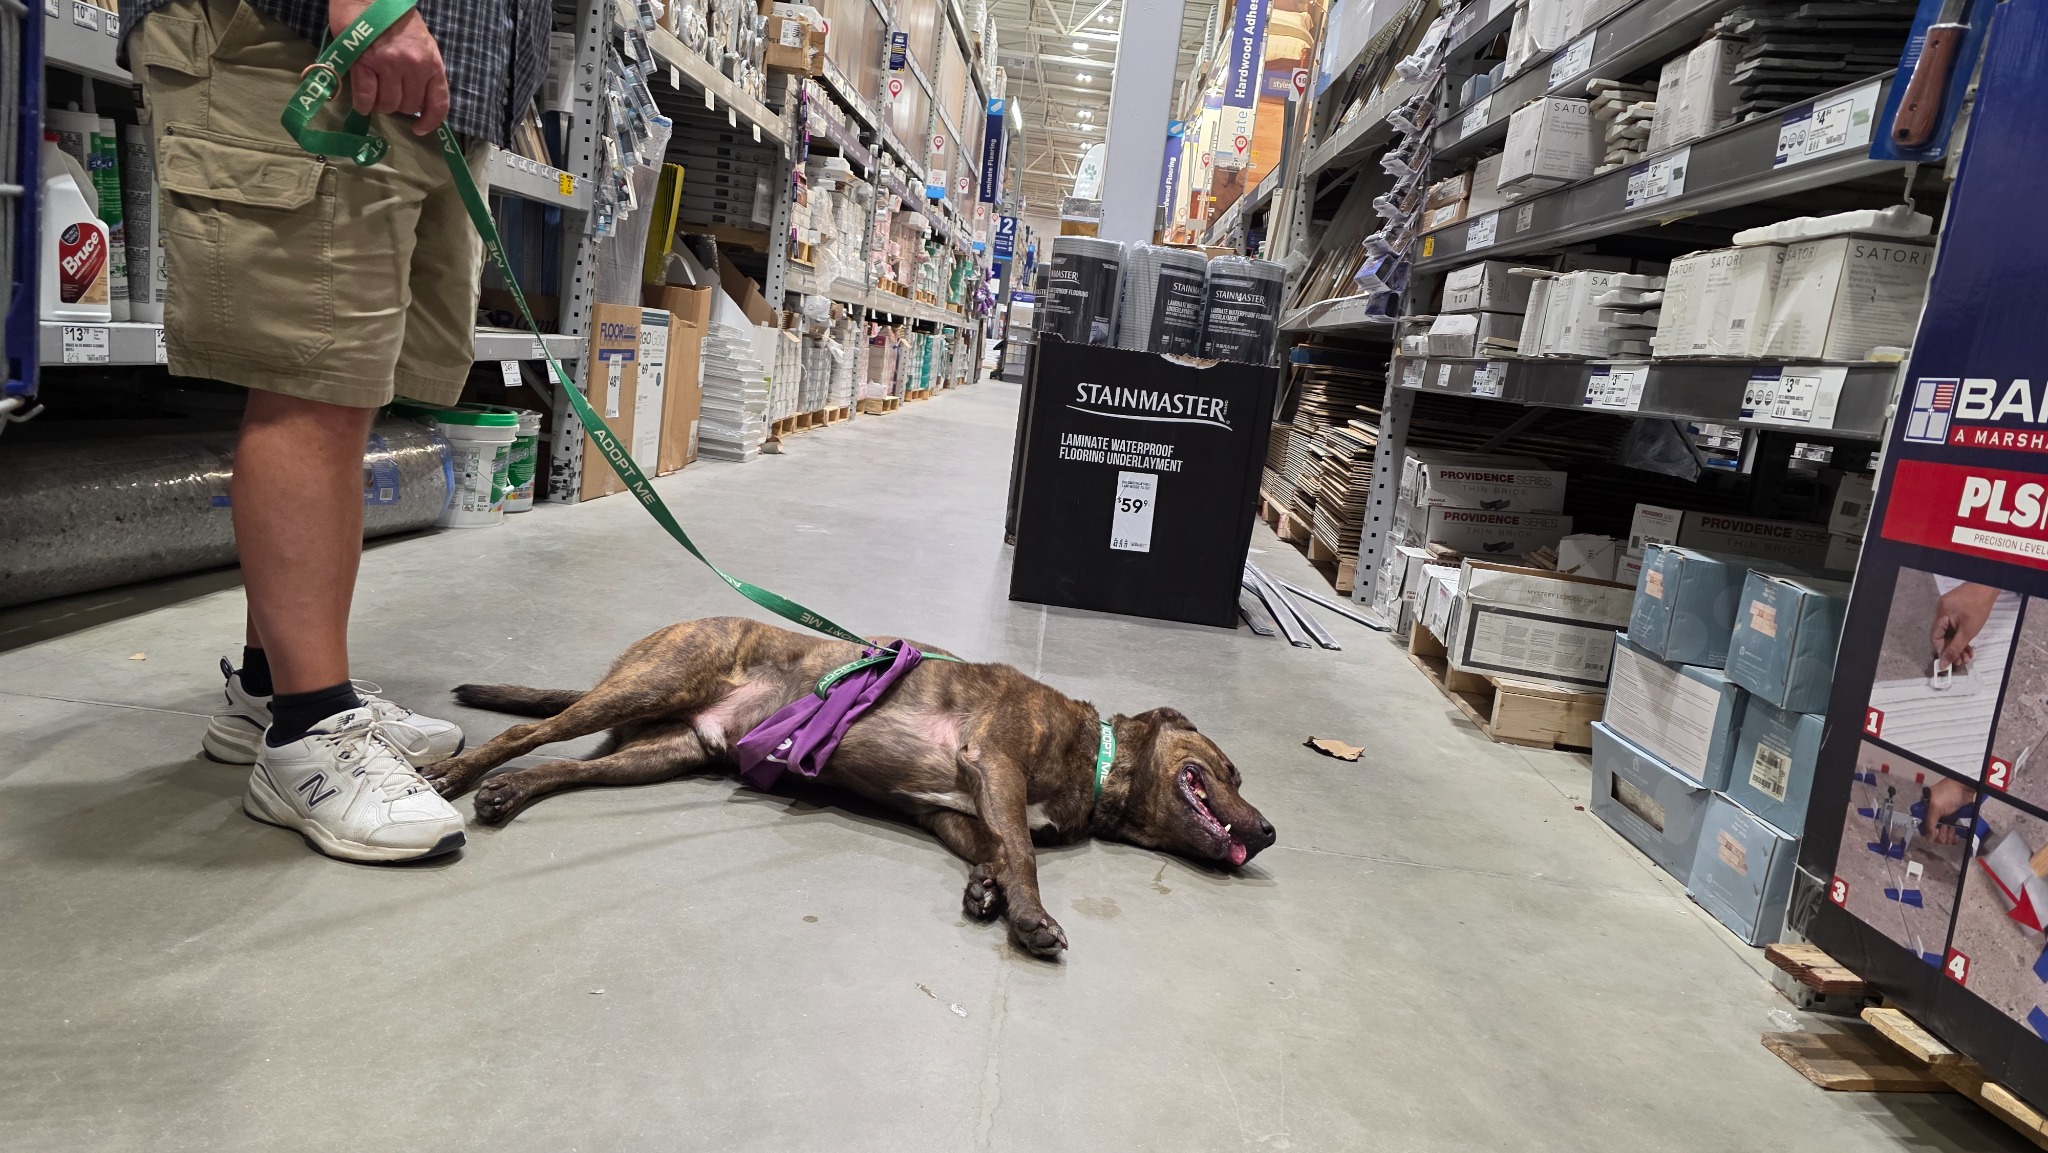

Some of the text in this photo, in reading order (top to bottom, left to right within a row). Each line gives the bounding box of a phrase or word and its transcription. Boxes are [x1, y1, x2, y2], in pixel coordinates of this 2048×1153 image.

[1462, 10, 1476, 24] Stone
[342, 20, 374, 51] ME
[1235, 37, 1254, 98] Hardwood
[985, 138, 998, 198] Laminate Flooring
[1165, 157, 1177, 185] Flooring
[996, 217, 1013, 234] 12
[62, 231, 99, 276] Bruce
[486, 240, 505, 268] ME
[1787, 246, 1819, 262] SATORI
[1854, 245, 1928, 265] SATORI
[1215, 290, 1266, 305] STAINMASTER
[600, 322, 624, 339] FLOOR
[1076, 382, 1226, 423] STAINMASTER
[1061, 432, 1175, 458] LAMINATE WATERPROOF
[1955, 429, 1965, 443] A
[593, 429, 656, 505] ADOPT ME
[1059, 447, 1184, 473] FLOORING UNDERLAYMENT
[1440, 470, 1553, 487] PROVIDENCE SERIES
[1462, 484, 1528, 497] THIN BRICK
[1443, 511, 1559, 529] PROVIDENCE SERIES
[1700, 515, 1793, 539] PROVIDENCE
[1467, 526, 1534, 538] THIN BRICK
[1973, 533, 2018, 551] PRECISION
[1726, 537, 1806, 555] THIN BRICK
[1527, 588, 1598, 605] MYSTERY LEDGESTONE
[800, 612, 824, 628] ME
[818, 662, 858, 691] ADOPT
[1867, 711, 1878, 734] 1
[1988, 761, 2008, 788] 2
[1832, 881, 1846, 903] 3
[1948, 954, 1965, 980] 4
